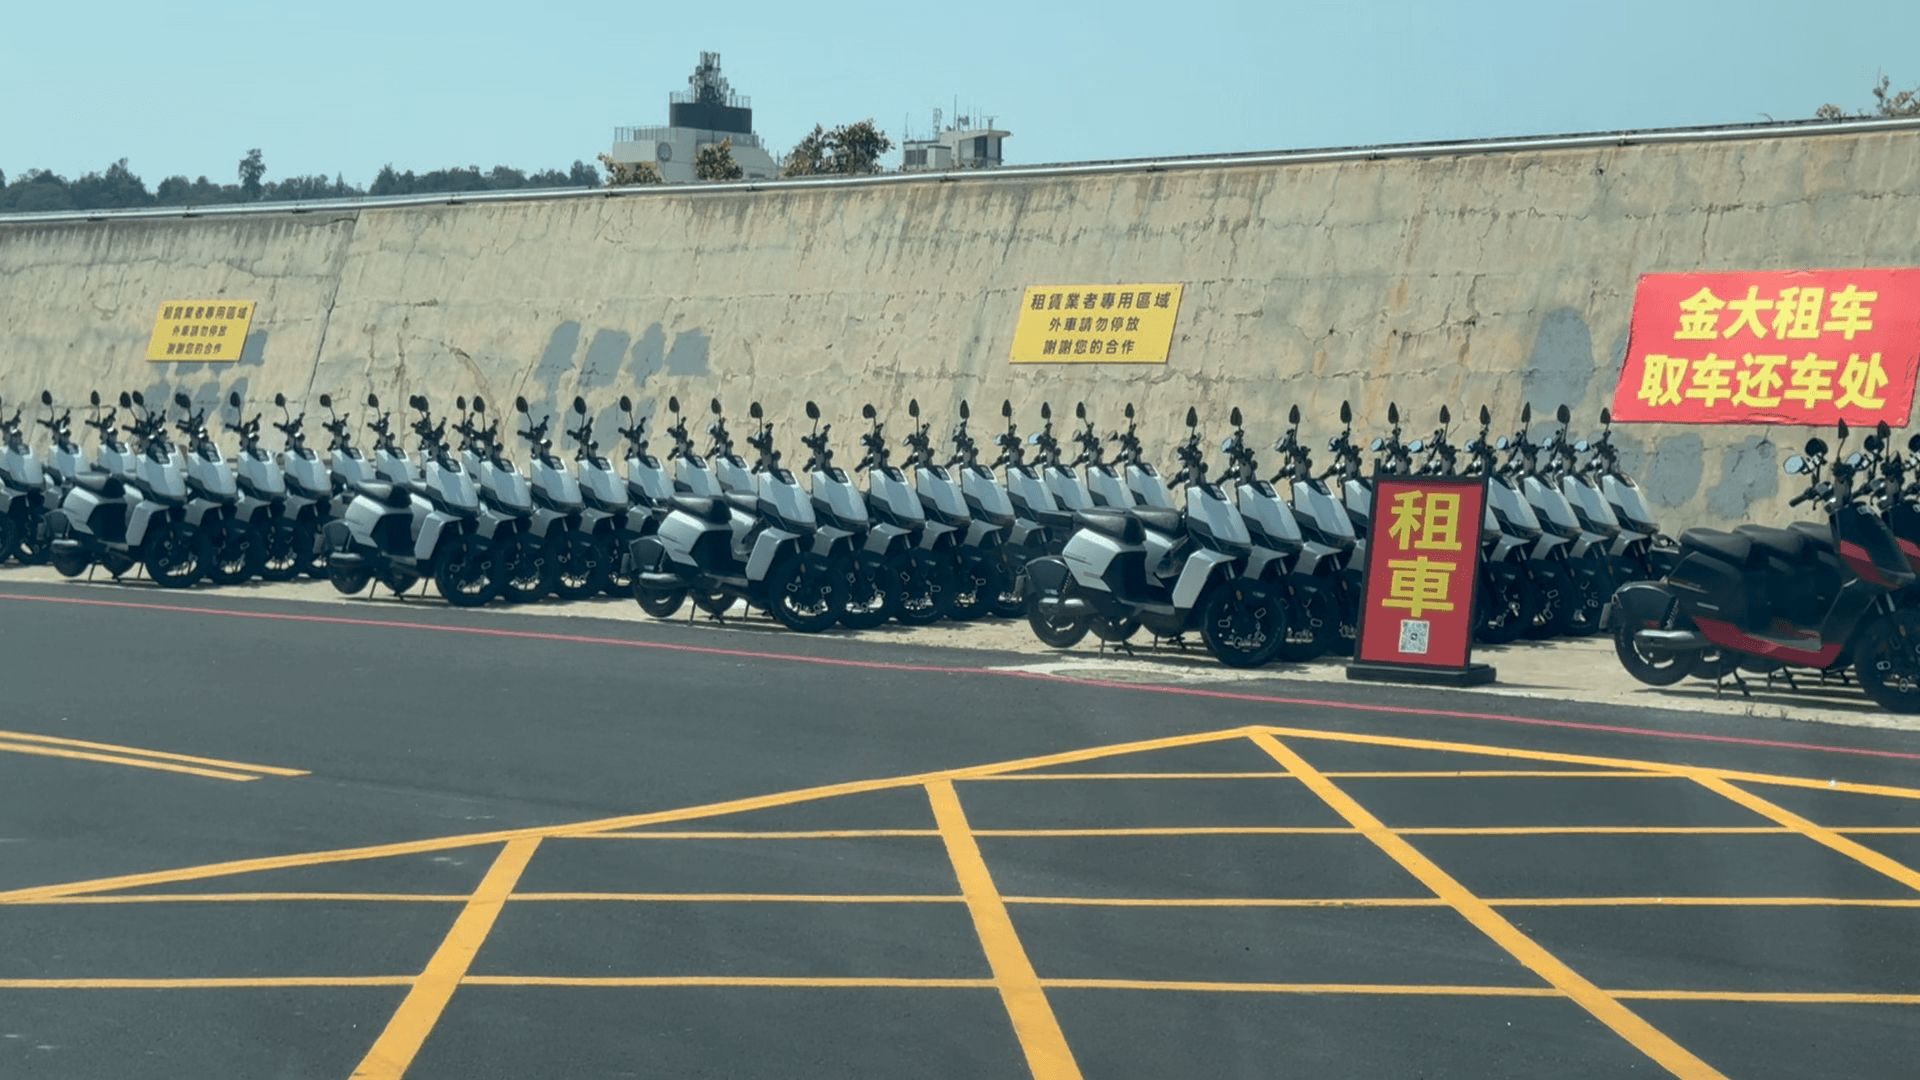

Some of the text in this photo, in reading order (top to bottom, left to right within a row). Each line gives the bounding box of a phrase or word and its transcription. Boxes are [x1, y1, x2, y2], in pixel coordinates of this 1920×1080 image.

[1030, 291, 1172, 311] 租賃業者專用區域
[1673, 284, 1879, 341] 金大租车
[1048, 316, 1141, 332] 外車請勿停放
[1042, 339, 1136, 355] 謝謝您的合作
[1637, 352, 1890, 410] 取车还车处
[1381, 489, 1463, 618] 租車
